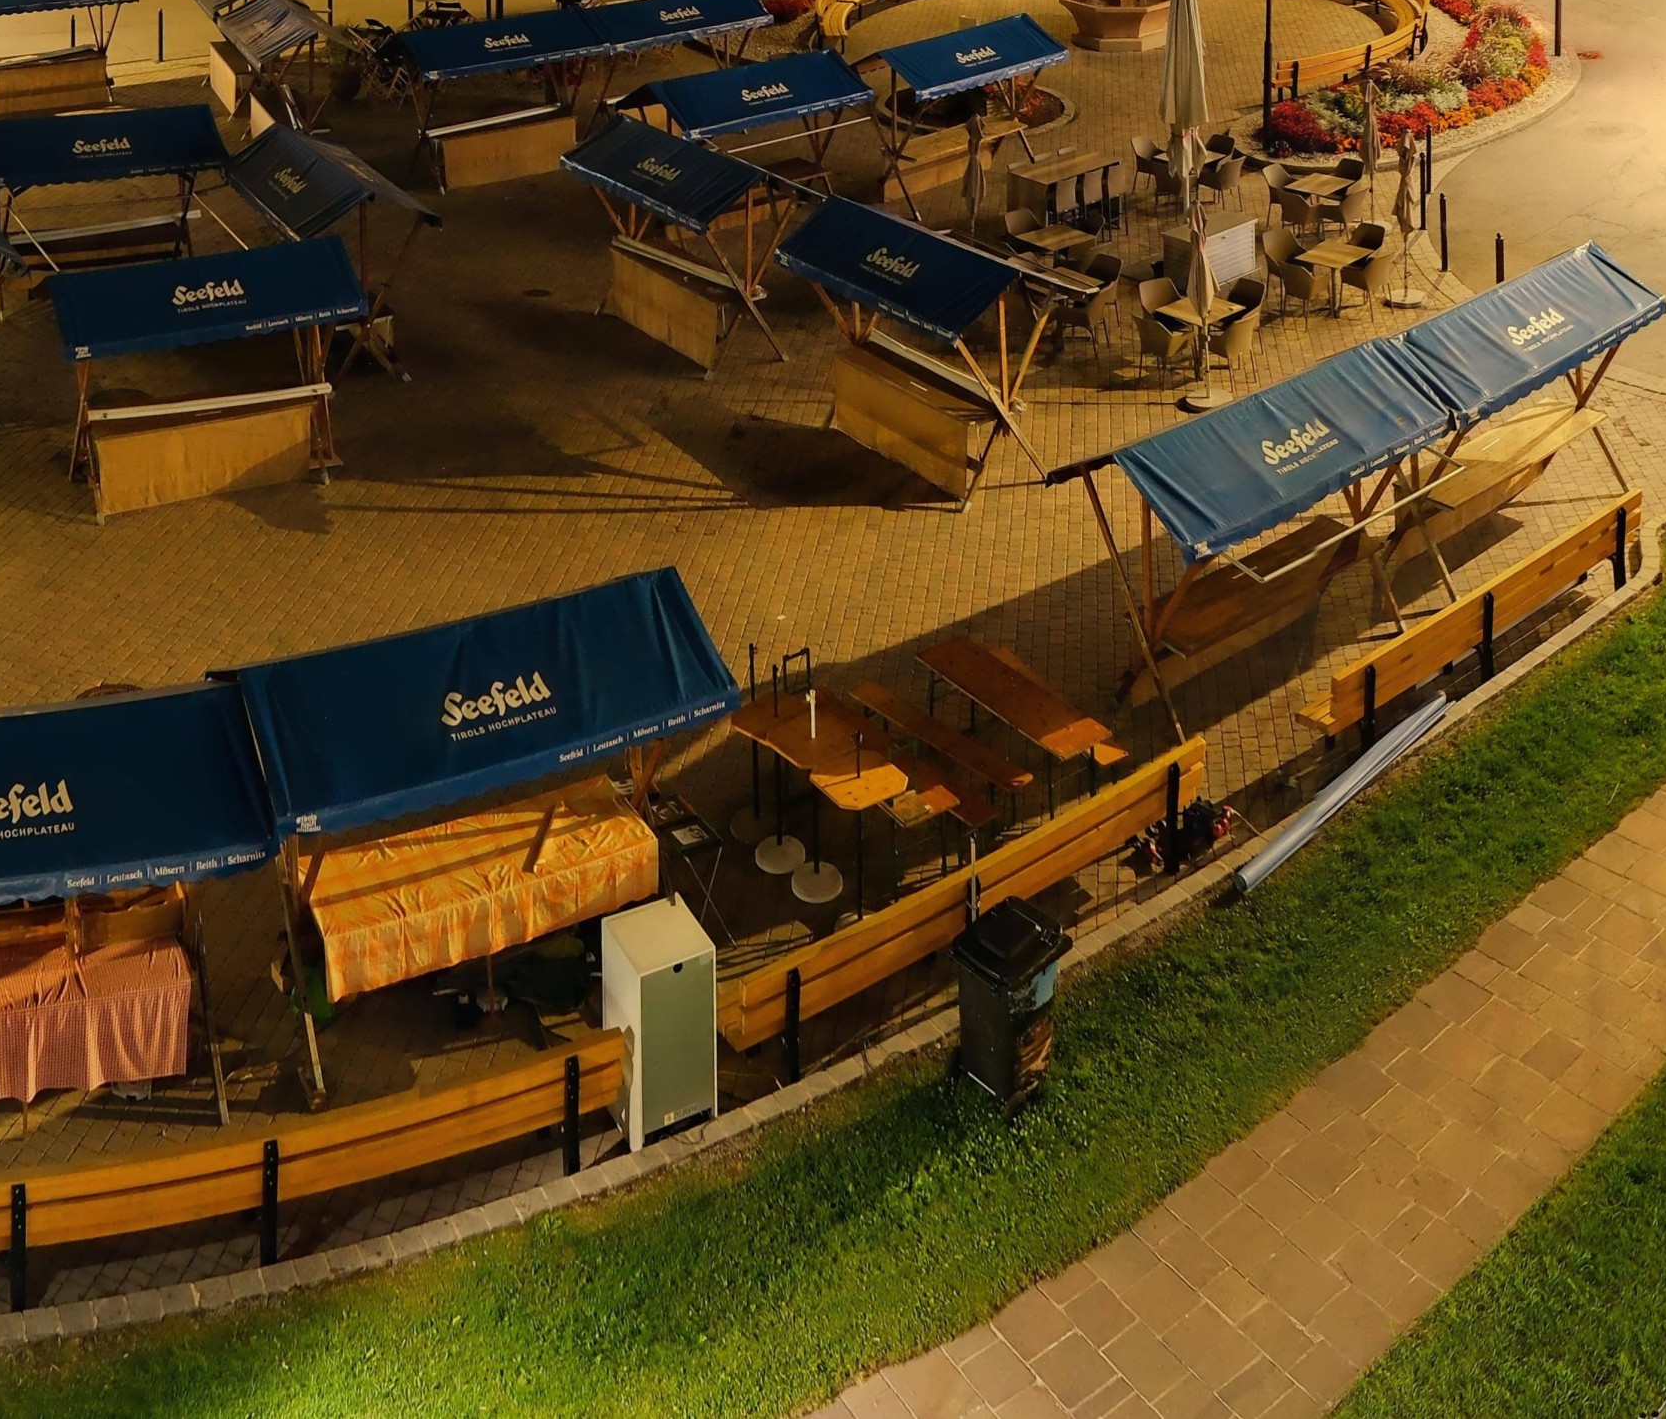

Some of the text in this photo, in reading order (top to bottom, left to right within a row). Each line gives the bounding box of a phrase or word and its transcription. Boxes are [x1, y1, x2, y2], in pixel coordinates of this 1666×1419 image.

[660, 6, 701, 21] Seefeld
[483, 34, 530, 50] Seefeld
[955, 46, 997, 64] Seefeld
[741, 83, 790, 102] Seefeld
[73, 137, 131, 155] Seefeld
[171, 279, 244, 306] Seefeld
[1511, 307, 1565, 347] Seefeld
[1261, 417, 1331, 465] Seefeld
[441, 672, 551, 728] Seefeld
[451, 706, 557, 743] TIROLS HOCHPLATEAU
[559, 748, 584, 763] Seefeld
[667, 714, 686, 729] Reith
[66, 849, 266, 889] Seefeld Leutasch Mösern Reith Scharnitz
